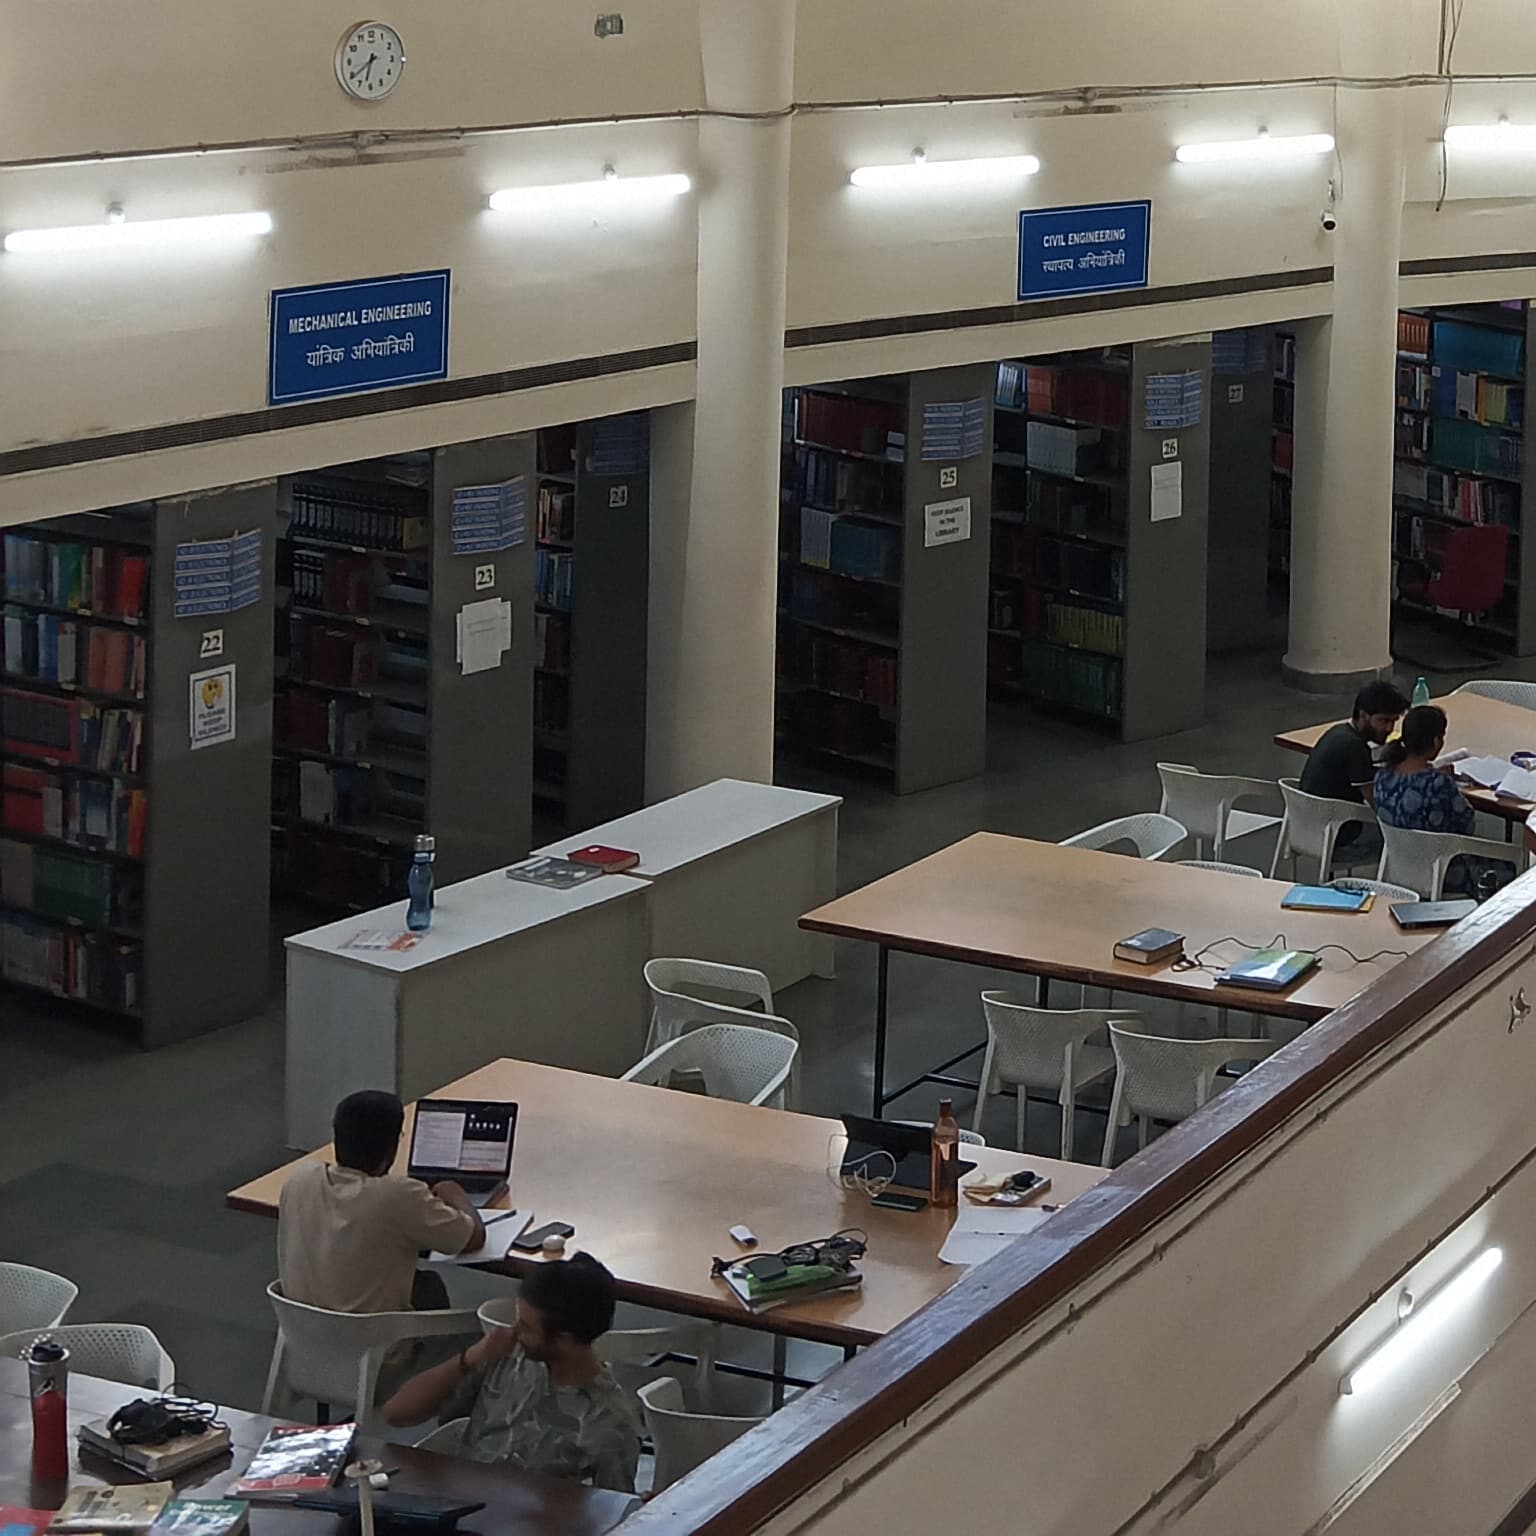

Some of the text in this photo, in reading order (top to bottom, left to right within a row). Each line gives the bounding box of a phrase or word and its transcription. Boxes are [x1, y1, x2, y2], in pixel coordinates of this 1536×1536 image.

[357, 34, 364, 42] 11
[368, 30, 375, 38] 12
[349, 44, 358, 52] 10
[1043, 228, 1126, 248] CIVIL ENGINEERING
[288, 300, 432, 334] MECHANICAL ENGINEERING
[306, 344, 346, 367] यांत्रिक
[1230, 388, 1241, 400] 27
[1163, 442, 1176, 455] 26
[941, 470, 955, 485] 25
[611, 489, 626, 504] 24
[935, 527, 960, 537] LIBRARY
[477, 568, 493, 586] 23
[202, 634, 221, 654] 22
